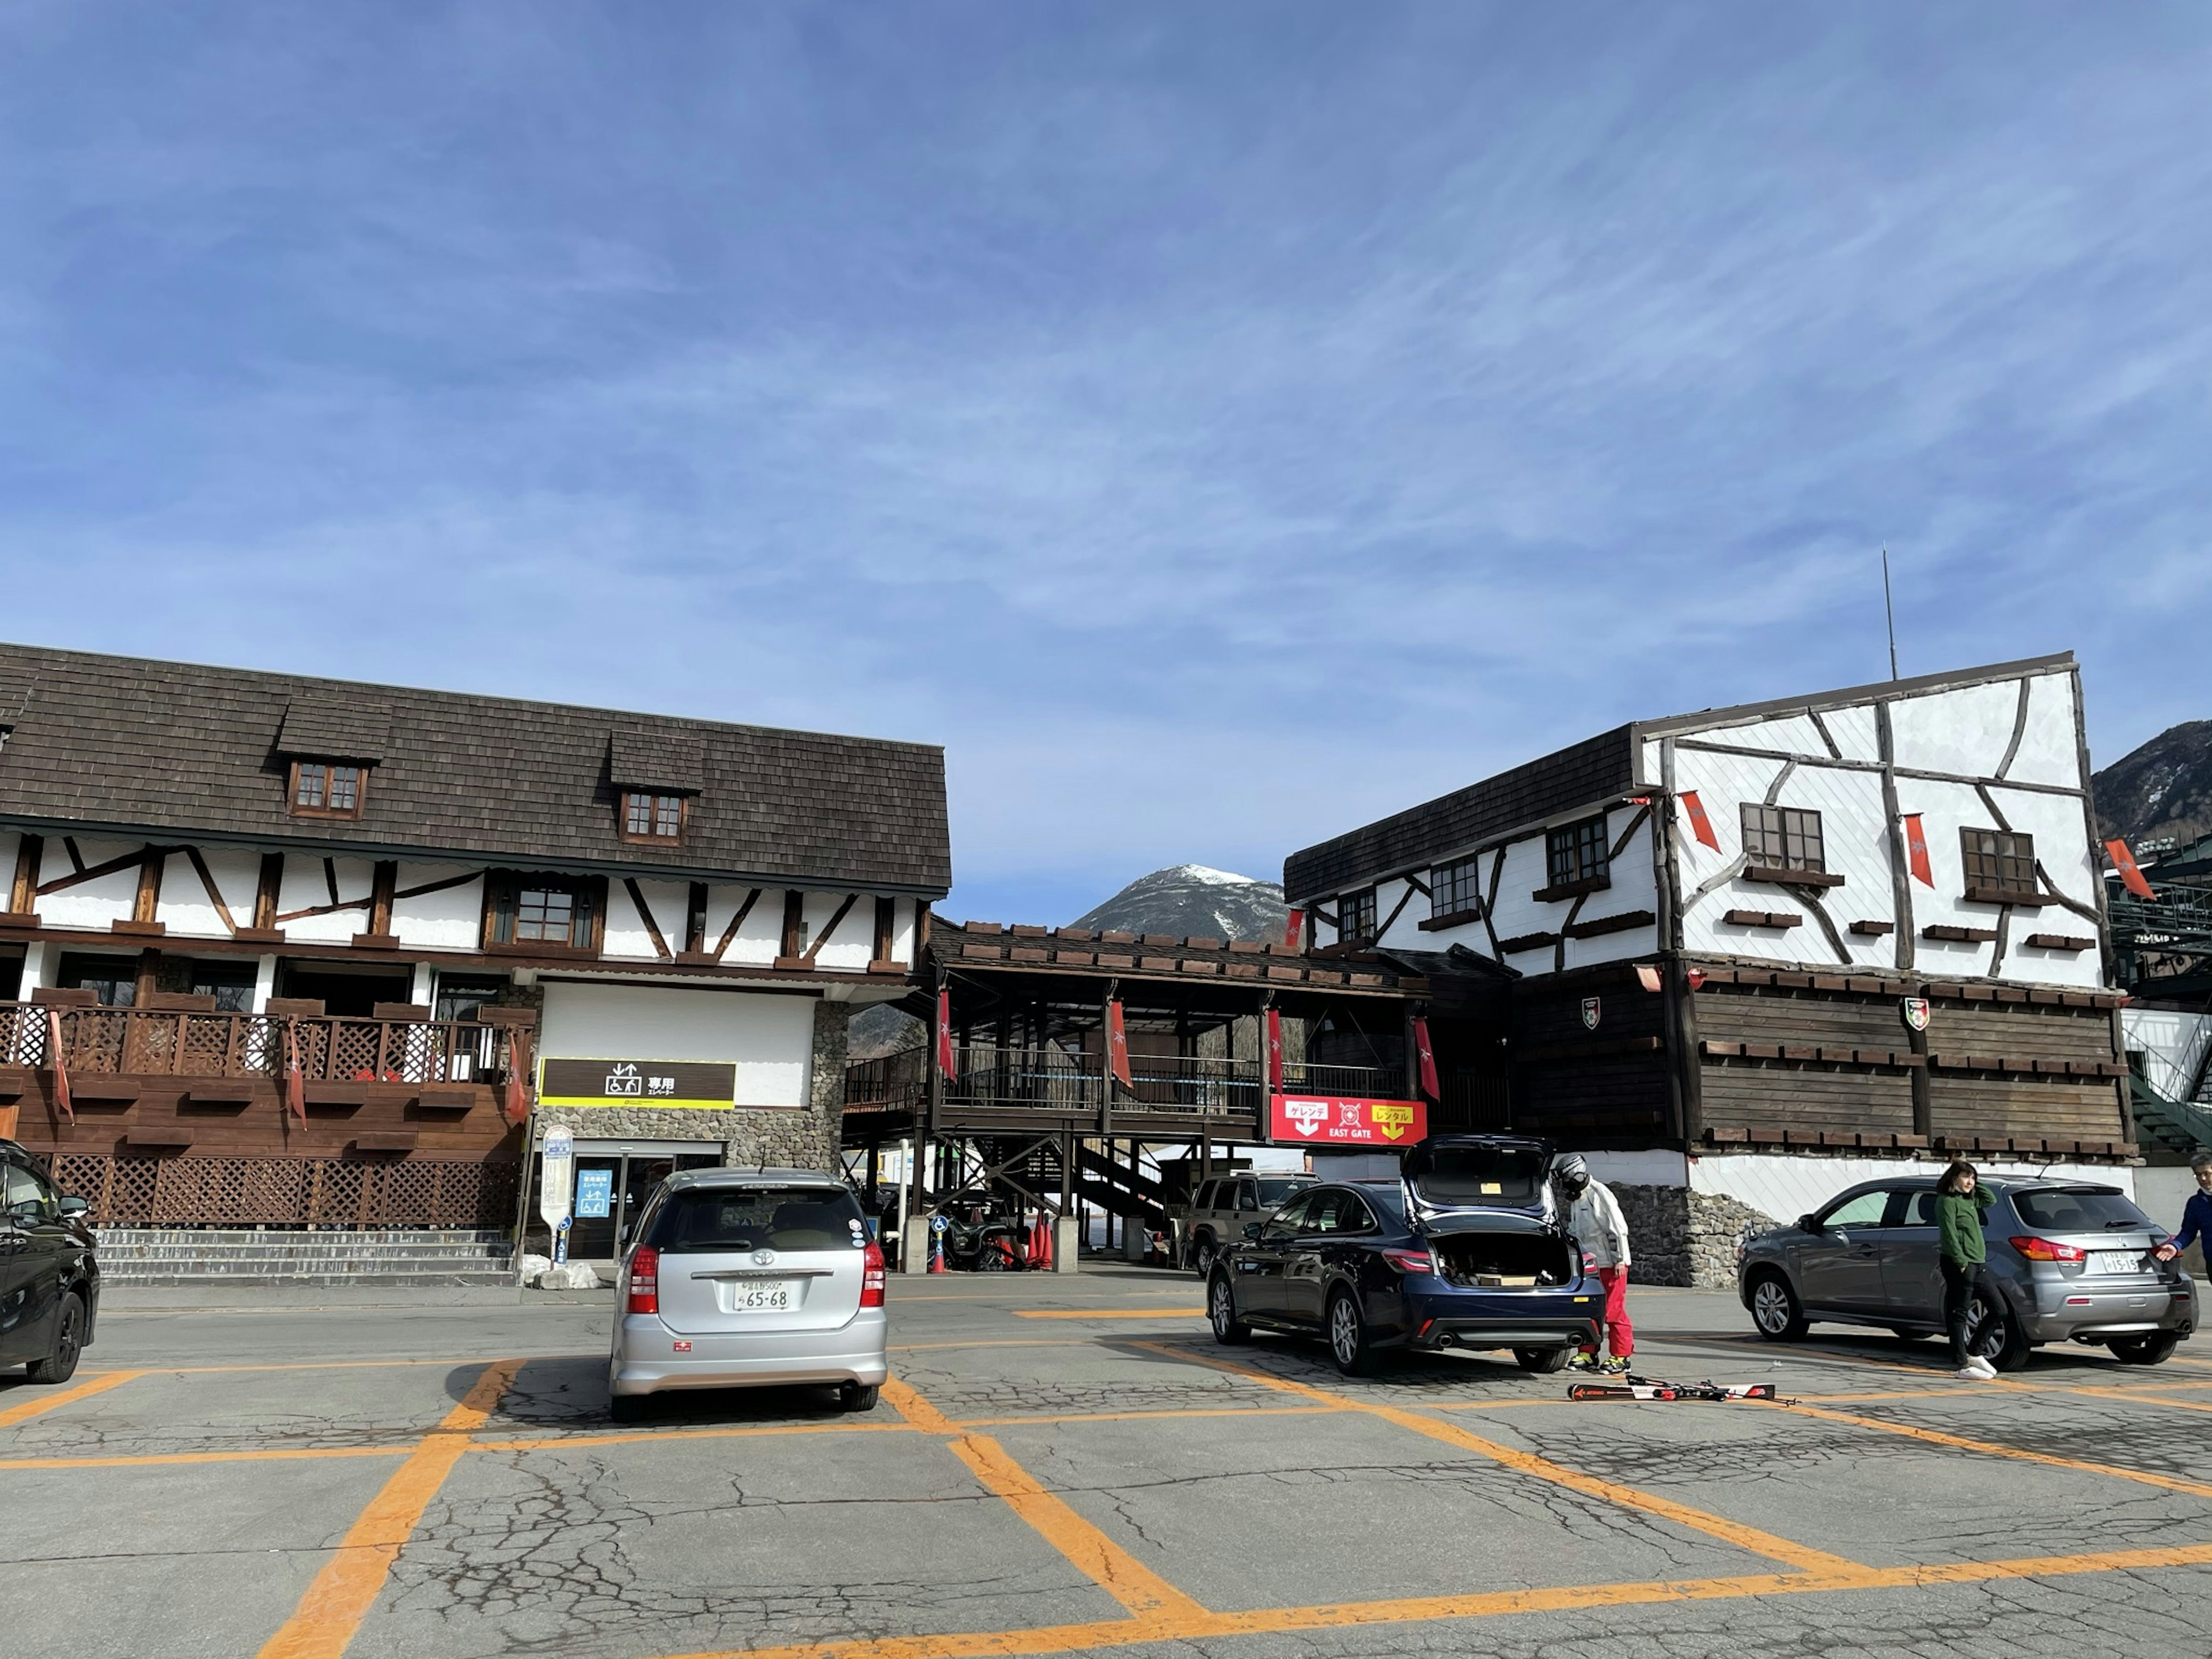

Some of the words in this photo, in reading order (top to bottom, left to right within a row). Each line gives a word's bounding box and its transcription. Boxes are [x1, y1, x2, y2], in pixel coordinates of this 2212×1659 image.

[647, 1077, 675, 1089] 専用
[1291, 1107, 1325, 1117] ゲレンデ
[1377, 1112, 1409, 1122] レンタル
[1329, 1128, 1349, 1138] EAST
[1351, 1129, 1372, 1139] GATE
[2112, 1259, 2137, 1271] 15-15
[747, 1291, 787, 1306] 65-68
